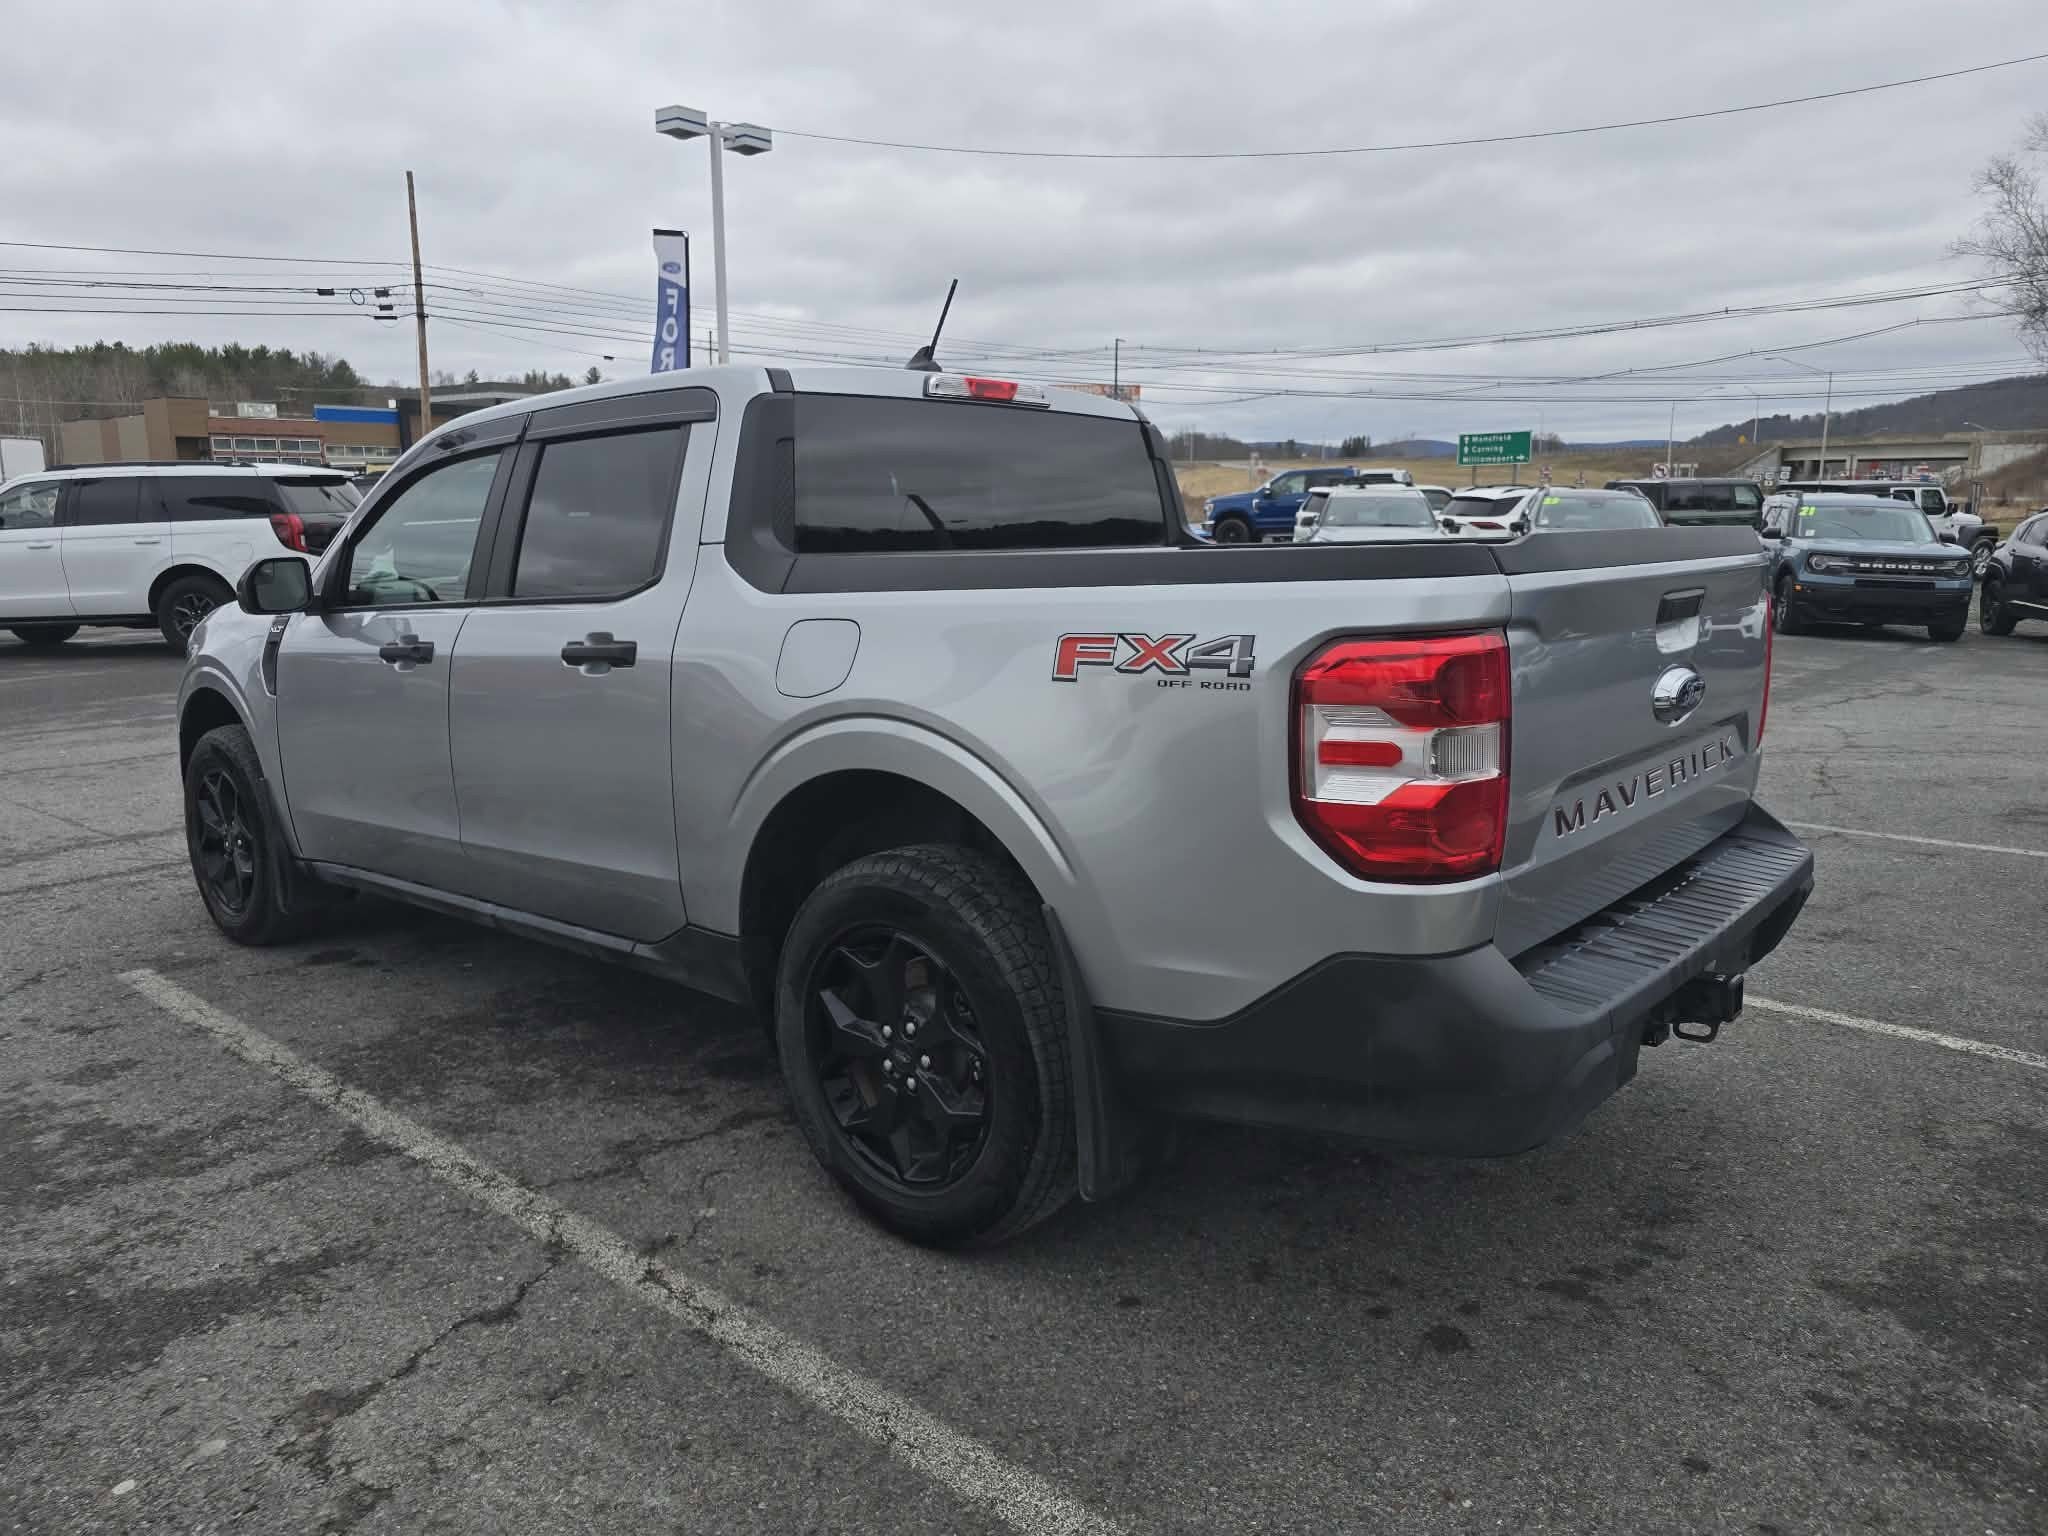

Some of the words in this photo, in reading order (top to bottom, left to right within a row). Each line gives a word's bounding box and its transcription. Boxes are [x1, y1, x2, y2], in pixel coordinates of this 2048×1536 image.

[1472, 445, 1504, 454] Corning
[1859, 562, 1935, 570] BRONCO
[1052, 633, 1256, 682] FX4
[1157, 680, 1193, 688] OFF
[1200, 681, 1251, 691] ROAD
[1554, 735, 1736, 839] MAVERICK
